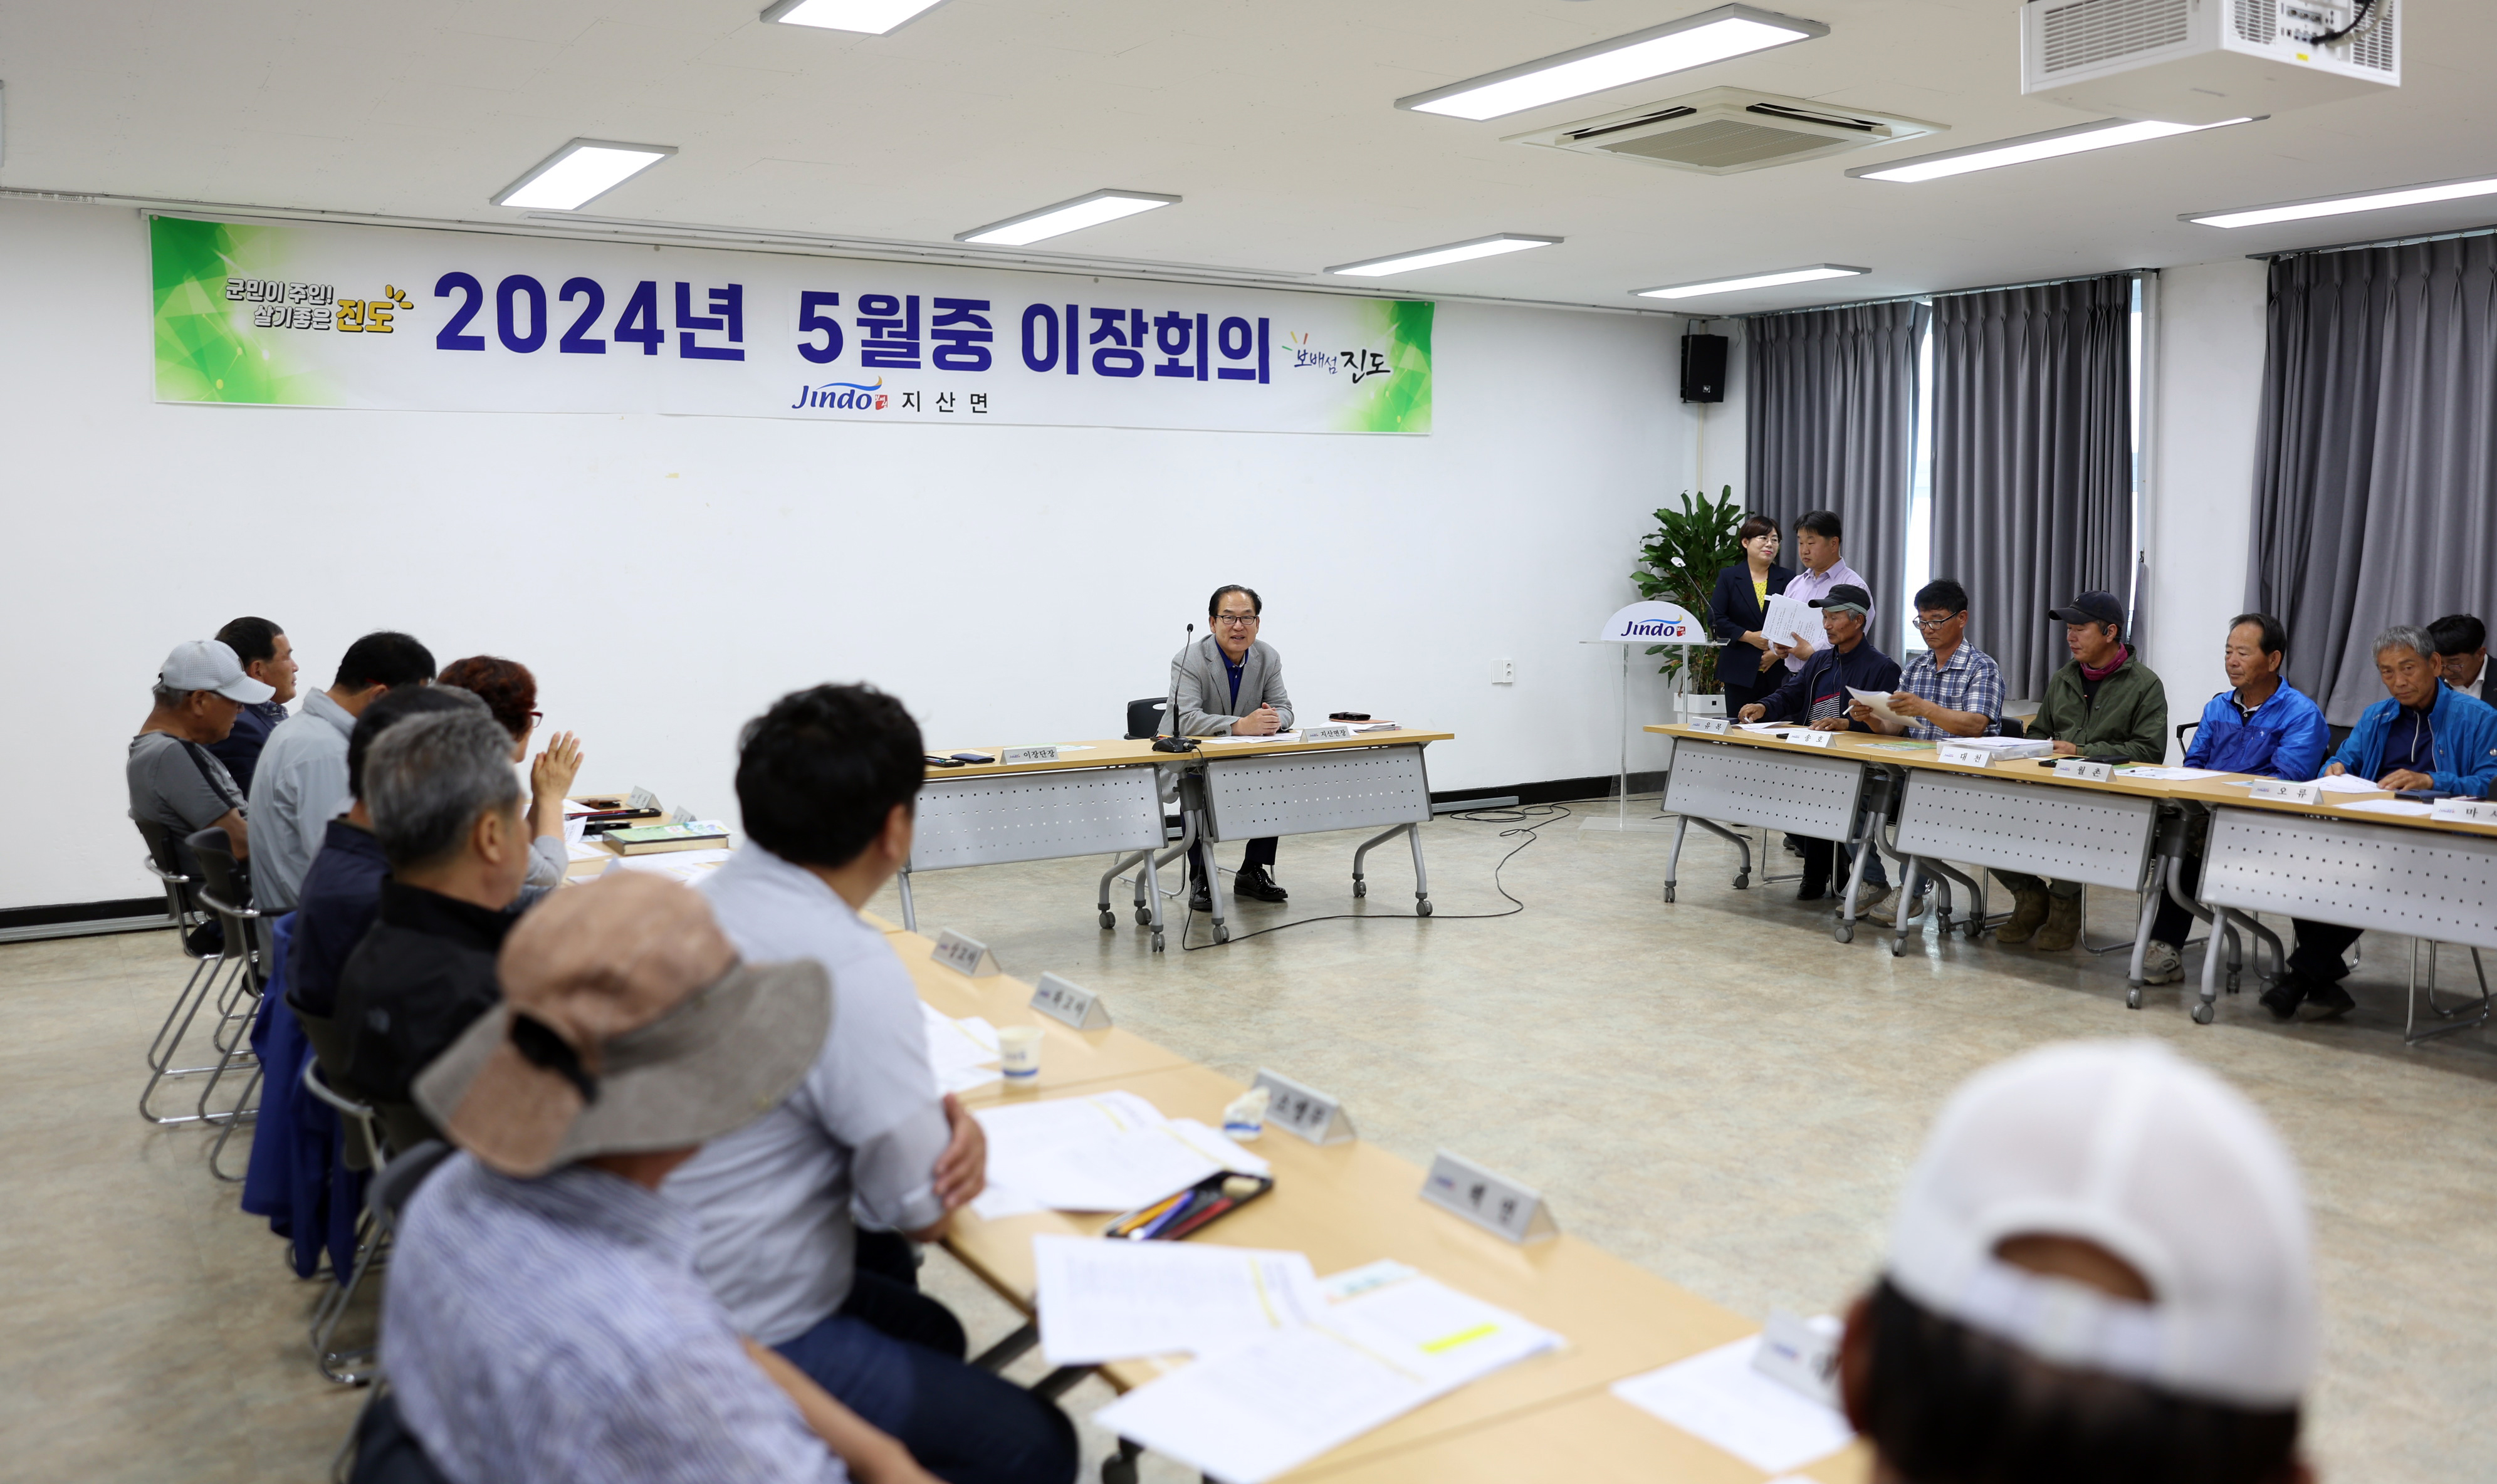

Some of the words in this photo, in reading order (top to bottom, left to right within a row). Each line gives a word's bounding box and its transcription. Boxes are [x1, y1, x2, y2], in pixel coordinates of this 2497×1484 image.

[226, 278, 285, 303] 군민이
[288, 282, 333, 305] 주인!
[254, 305, 332, 330] 살기좋은
[336, 299, 394, 333] 진도
[434, 271, 745, 362] 2024년
[797, 290, 994, 372] 5월중
[1021, 303, 1271, 385] 이장회의
[1294, 349, 1337, 374] 보배섬
[1340, 349, 1391, 384] 진도
[792, 385, 872, 410] Jindo
[1621, 621, 1675, 636] Jindo
[1321, 729, 1346, 738] 지산면장
[1023, 750, 1055, 759] 이장단장
